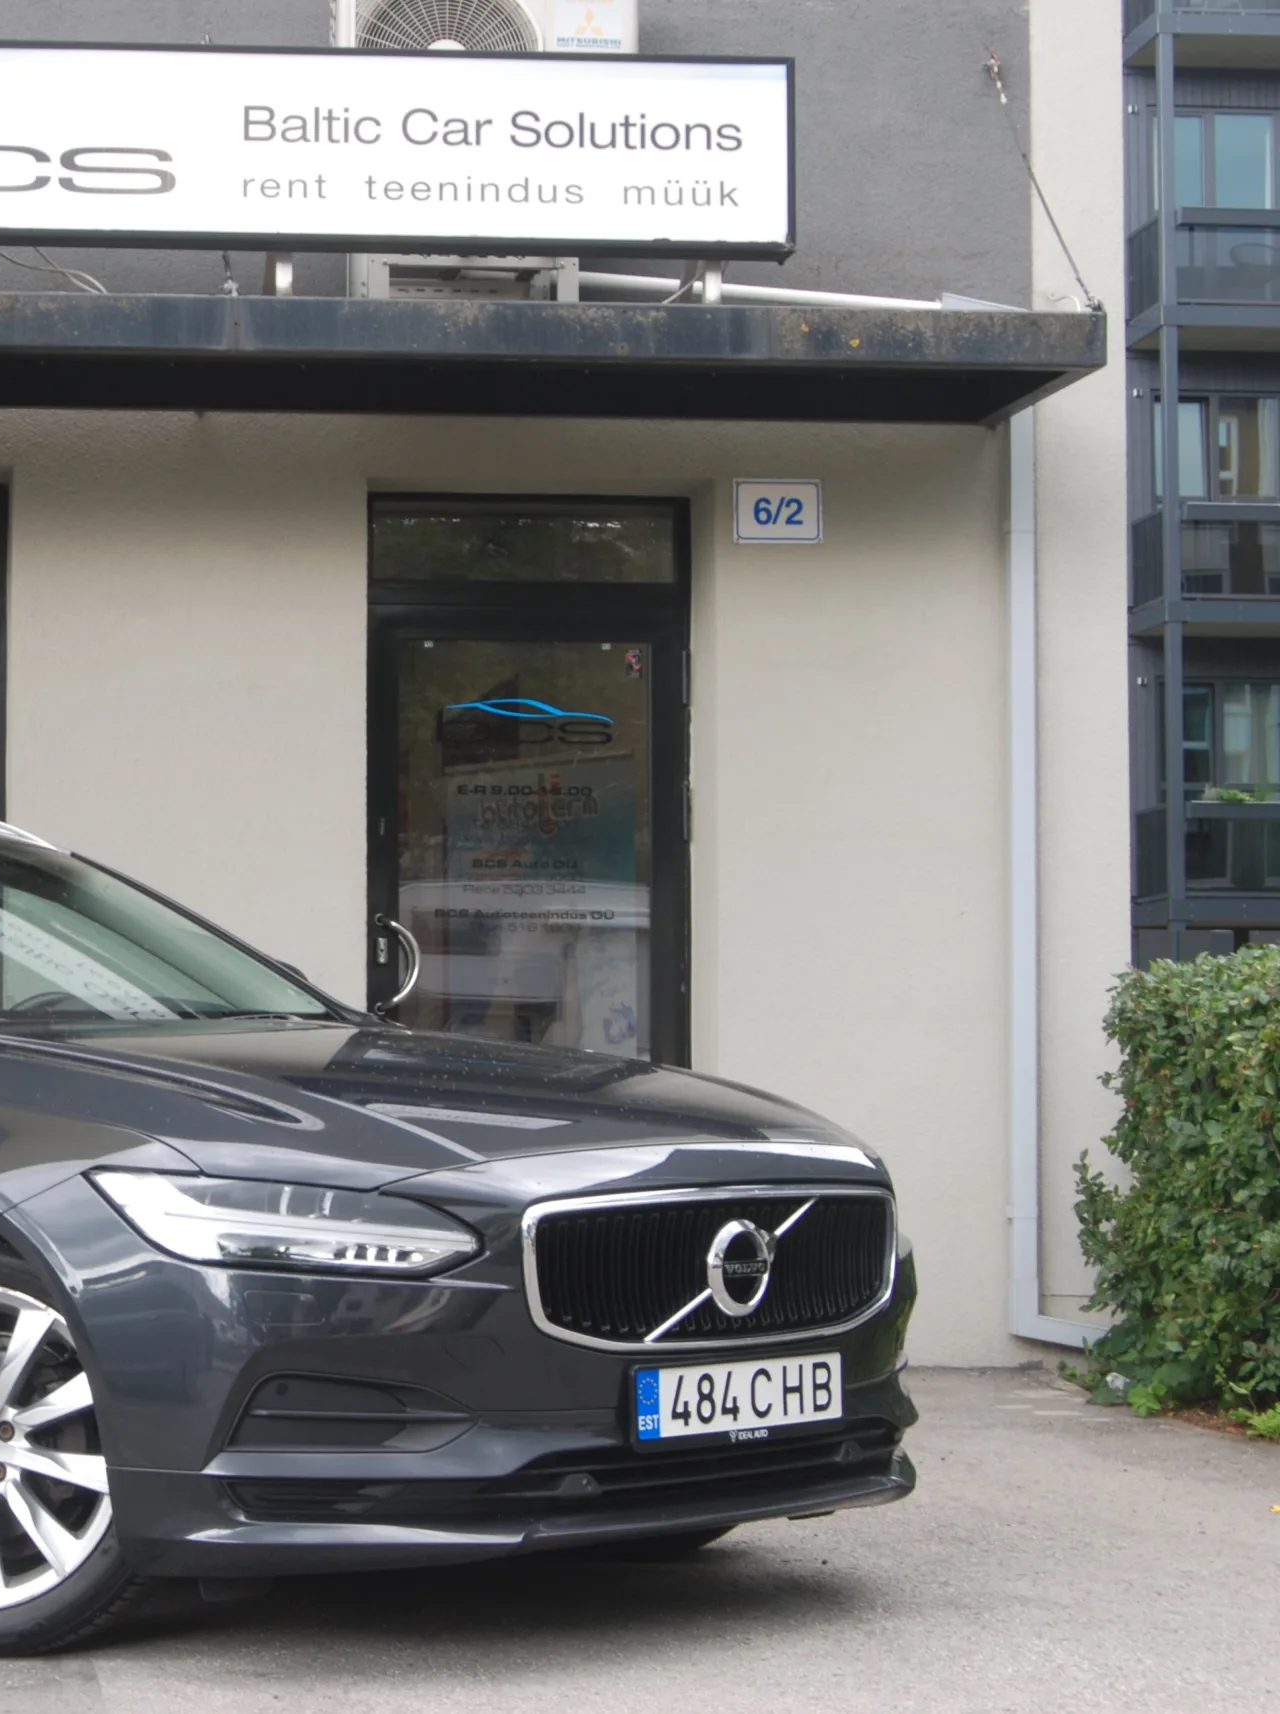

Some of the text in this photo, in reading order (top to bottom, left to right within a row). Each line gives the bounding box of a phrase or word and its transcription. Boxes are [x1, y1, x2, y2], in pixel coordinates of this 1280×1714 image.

[243, 105, 743, 152] Baltic Car Solutions
[242, 173, 741, 208] rent teenindus müük
[753, 496, 804, 526] 6/2
[724, 1262, 766, 1275] VOLVO
[637, 1414, 660, 1431] EST
